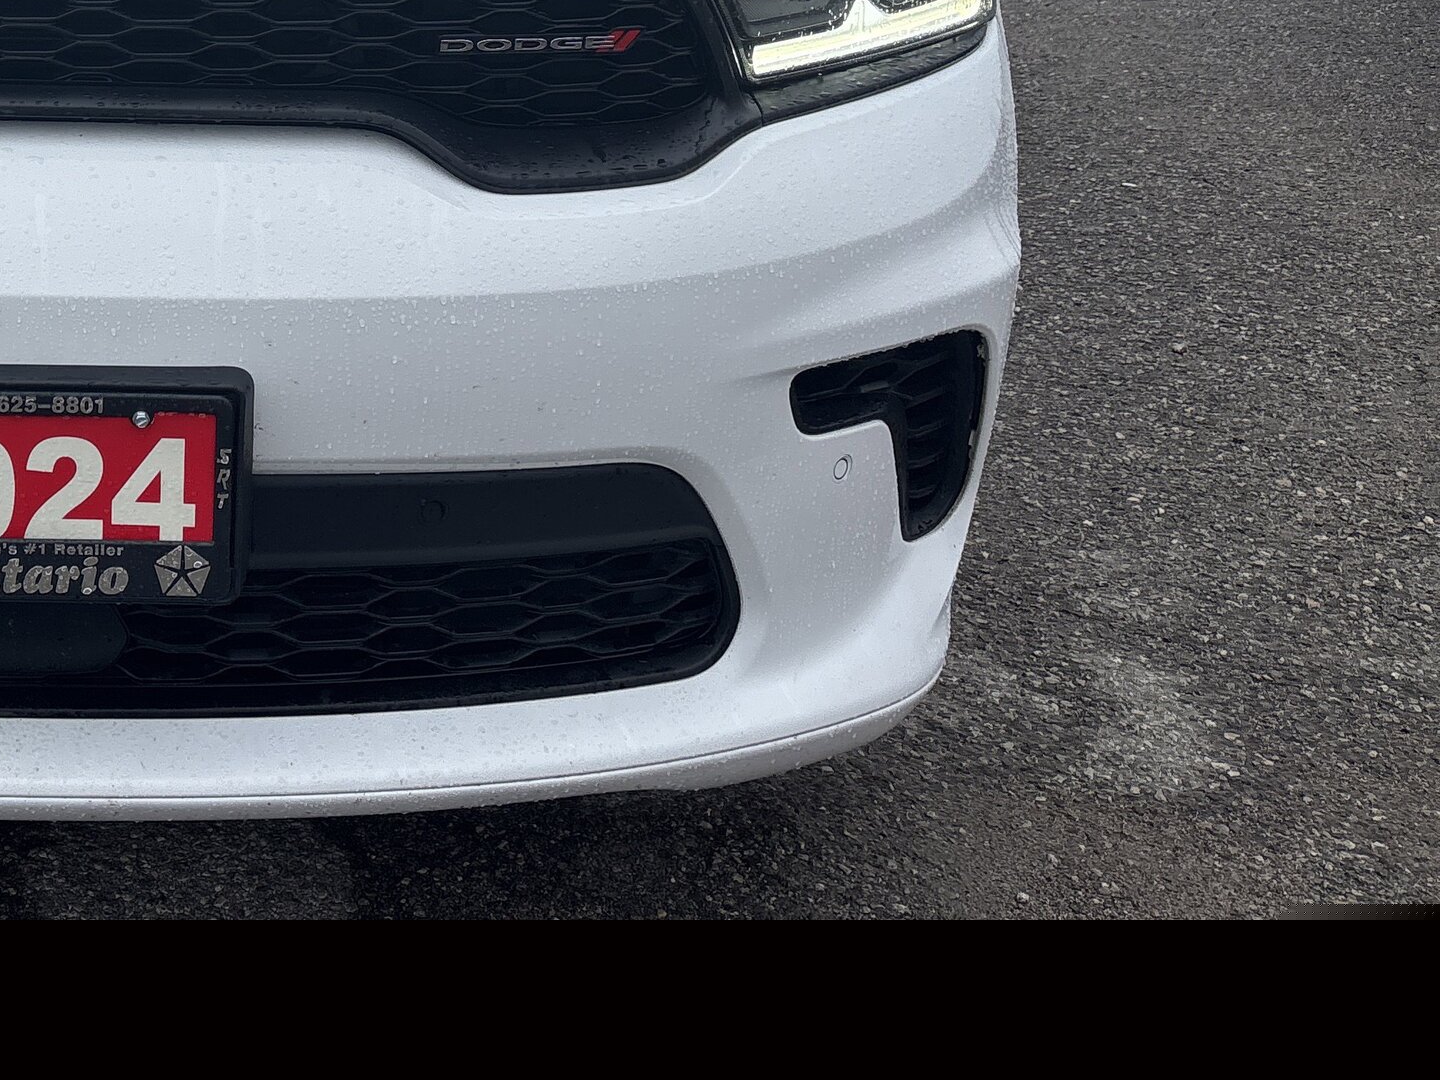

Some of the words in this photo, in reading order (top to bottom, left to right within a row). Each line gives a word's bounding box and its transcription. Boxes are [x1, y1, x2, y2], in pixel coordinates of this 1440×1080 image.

[439, 35, 616, 53] DODGE
[216, 448, 233, 510] SRT
[23, 544, 47, 555] #1
[54, 544, 125, 557] Retailer
